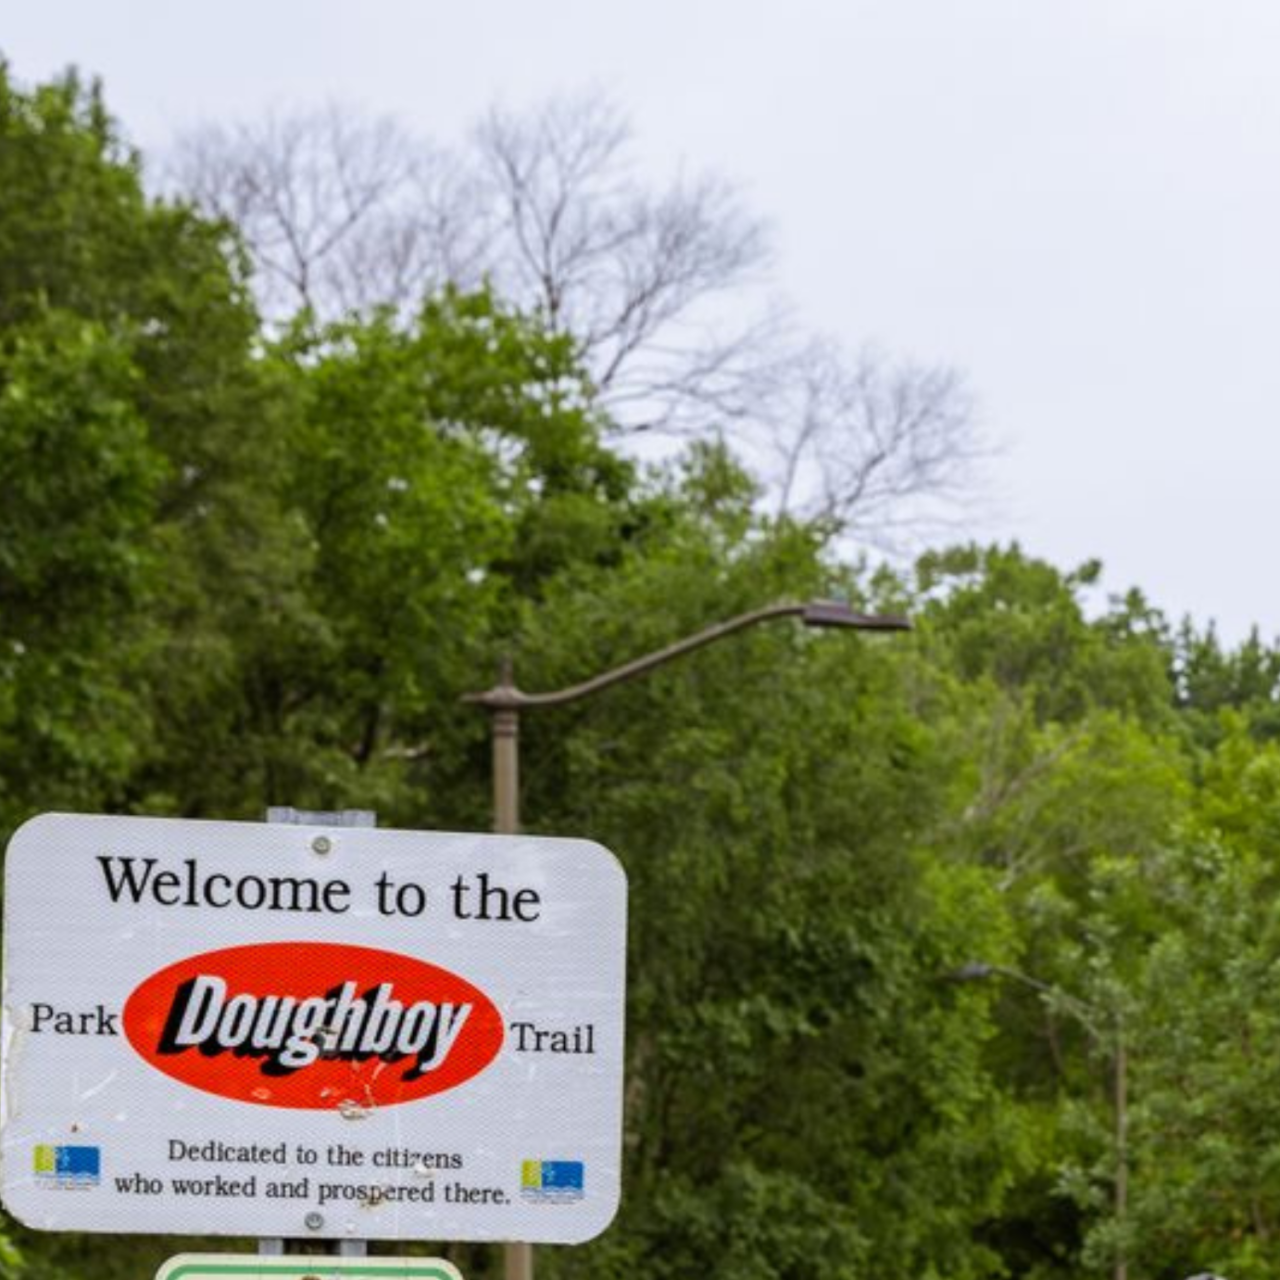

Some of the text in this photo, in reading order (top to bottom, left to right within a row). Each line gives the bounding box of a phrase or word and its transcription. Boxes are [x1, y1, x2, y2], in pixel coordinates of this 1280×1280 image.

[97, 856, 541, 921] Welcome to the
[30, 974, 595, 1080] Park Doughboy Trail
[168, 1139, 463, 1169] Dedicated to the citizens
[114, 1173, 163, 1195] who
[172, 1176, 256, 1198] worked
[265, 1178, 310, 1200] and
[318, 1180, 435, 1204] prospered
[444, 1183, 511, 1205] there.
